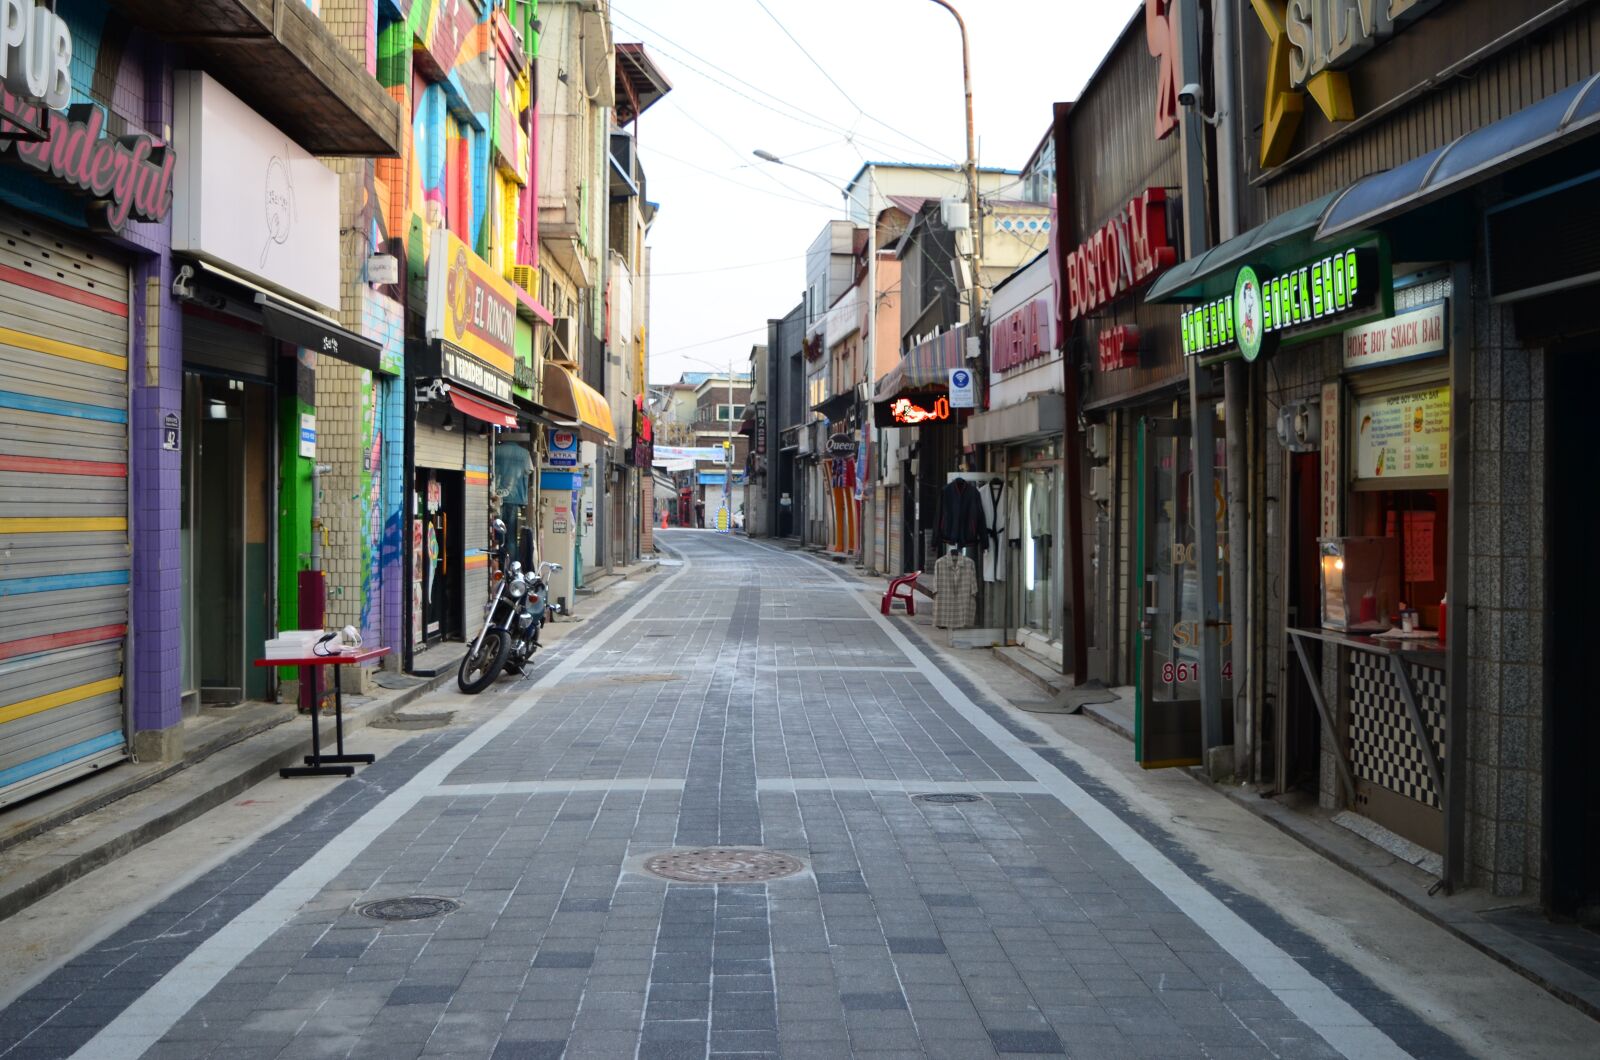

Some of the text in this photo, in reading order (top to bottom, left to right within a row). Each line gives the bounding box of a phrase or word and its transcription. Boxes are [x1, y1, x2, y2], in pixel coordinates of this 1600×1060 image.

[0, 0, 73, 110] PUB
[1286, 0, 1418, 88] SIL
[1067, 208, 1133, 321] BOSTON
[1262, 267, 1312, 333] SNACK
[1312, 248, 1358, 319] SHOP
[474, 286, 484, 329] EL
[1347, 316, 1440, 358] HOME BOY SNACK BAR
[826, 438, 855, 453] Queen
